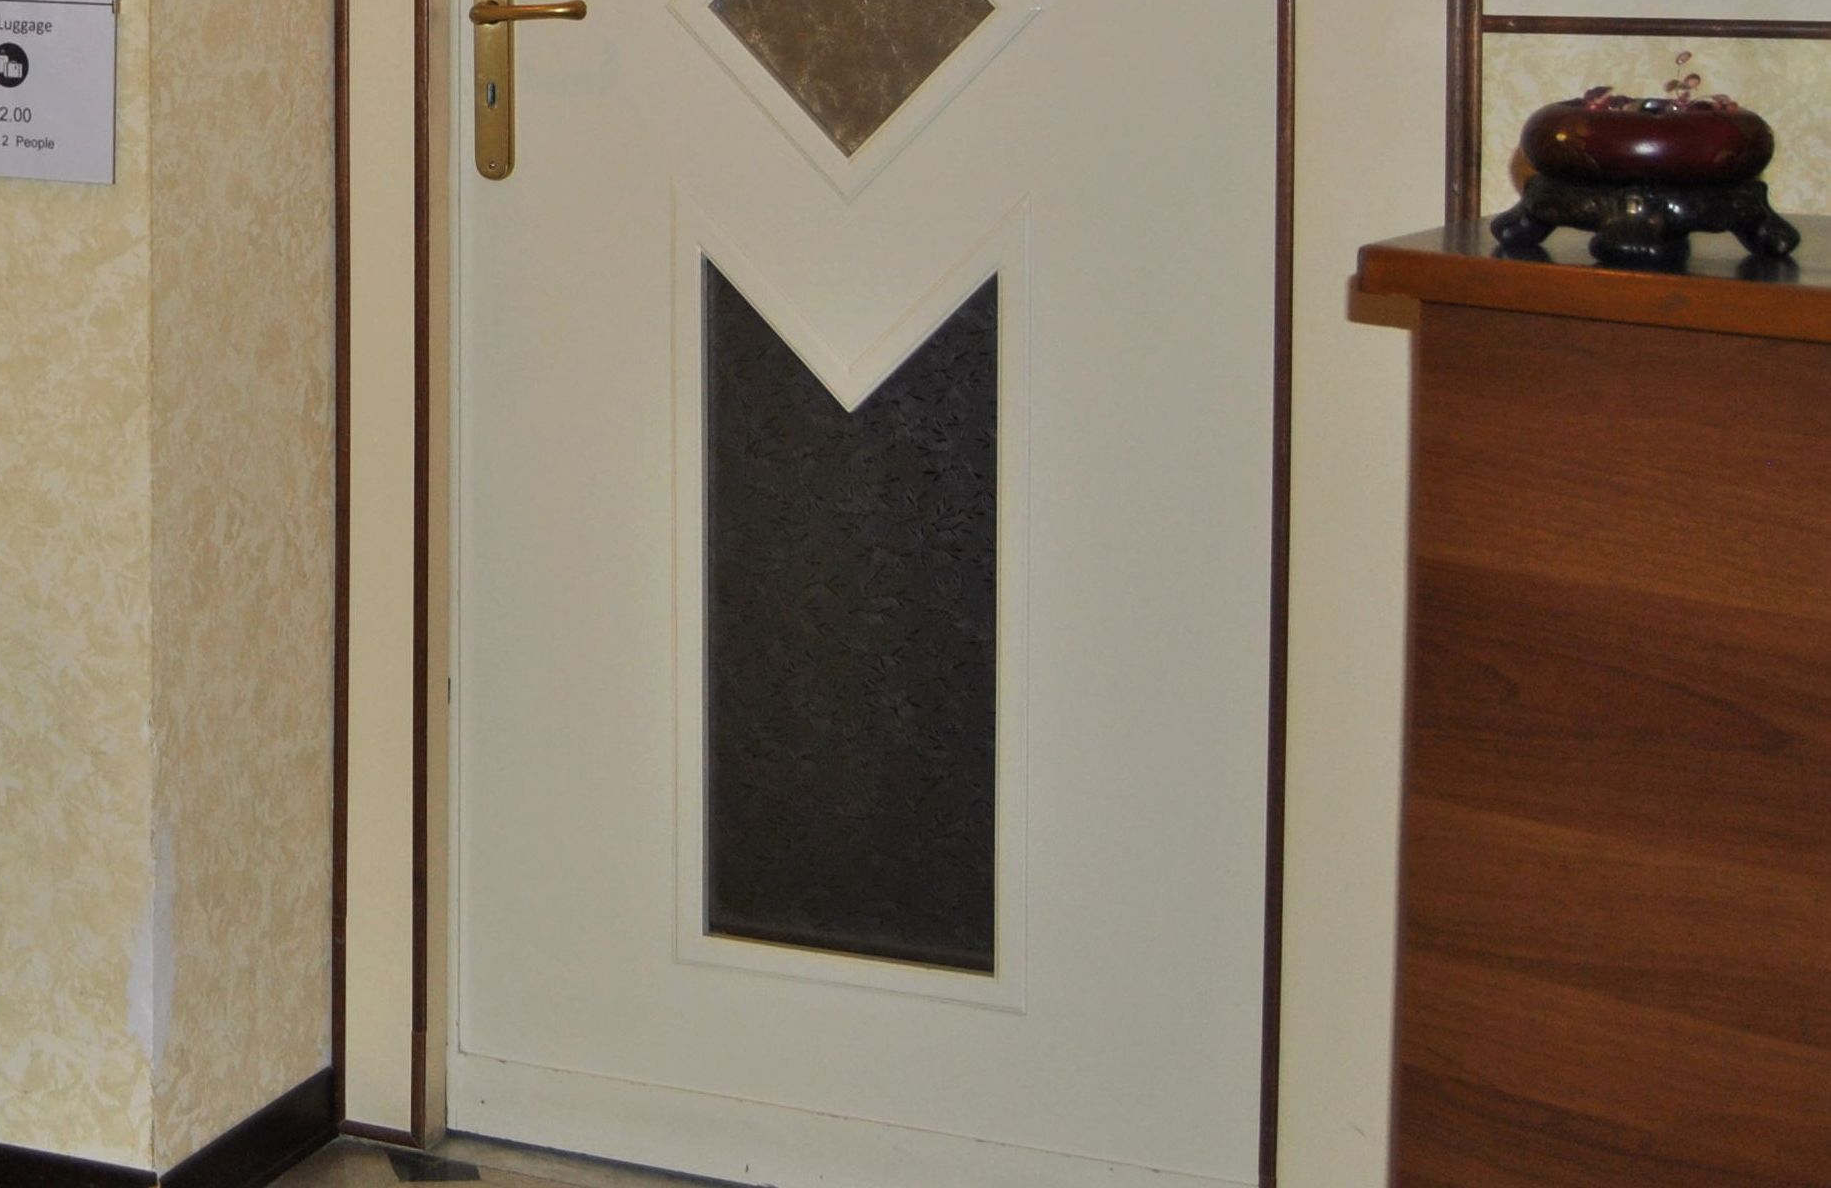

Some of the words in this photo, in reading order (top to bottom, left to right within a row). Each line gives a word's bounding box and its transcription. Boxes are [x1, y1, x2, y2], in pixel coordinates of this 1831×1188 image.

[0, 106, 32, 123] 2.00
[1, 134, 9, 147] 2
[15, 135, 55, 151] People
